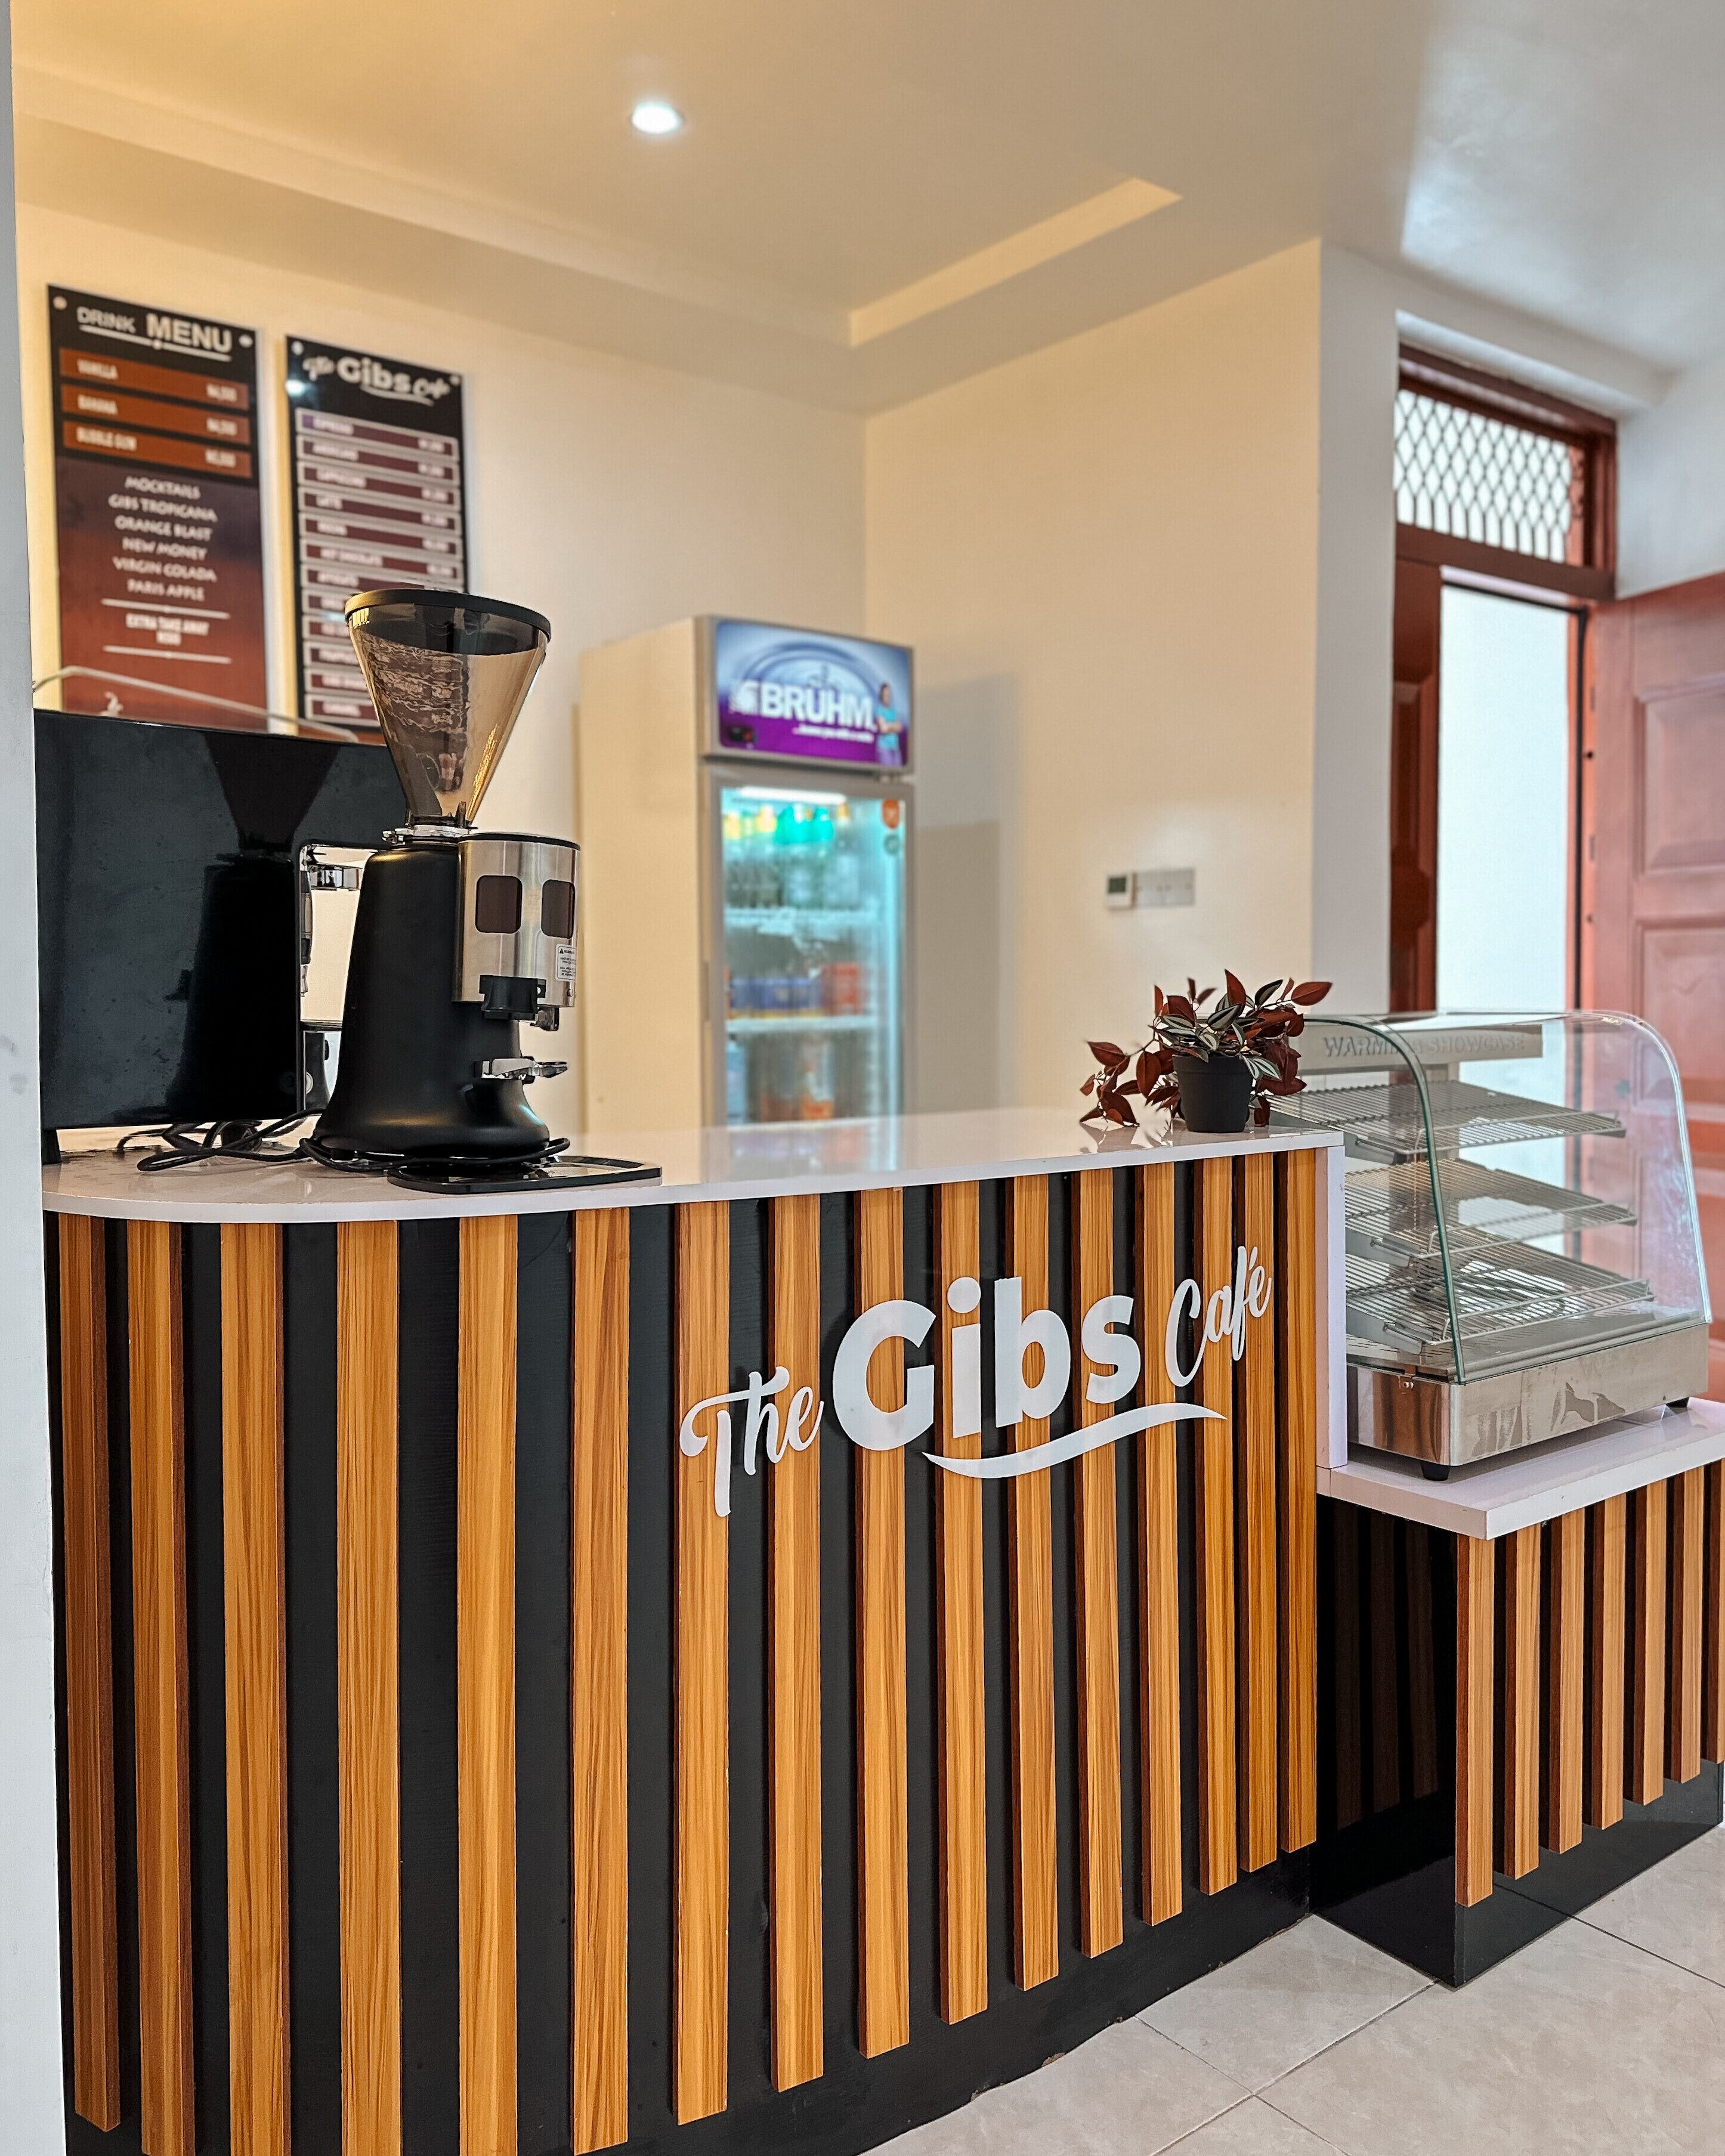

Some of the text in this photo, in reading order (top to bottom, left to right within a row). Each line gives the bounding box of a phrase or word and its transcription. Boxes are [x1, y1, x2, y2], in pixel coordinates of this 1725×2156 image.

[76, 307, 233, 353] DRINK MENU
[336, 356, 412, 394] Gibs
[125, 476, 200, 500] MOCKTAILS
[108, 493, 218, 522] GIBS TROPICANA
[115, 515, 213, 542] ORANGE BLAST
[122, 537, 208, 561] NEW MONEY
[112, 556, 217, 583] VIRGIN COLADA
[126, 579, 205, 602] PARIS APPLE
[1427, 1034, 1525, 1054] SHOWCASE
[680, 1245, 1272, 1517] The Gibs Café
